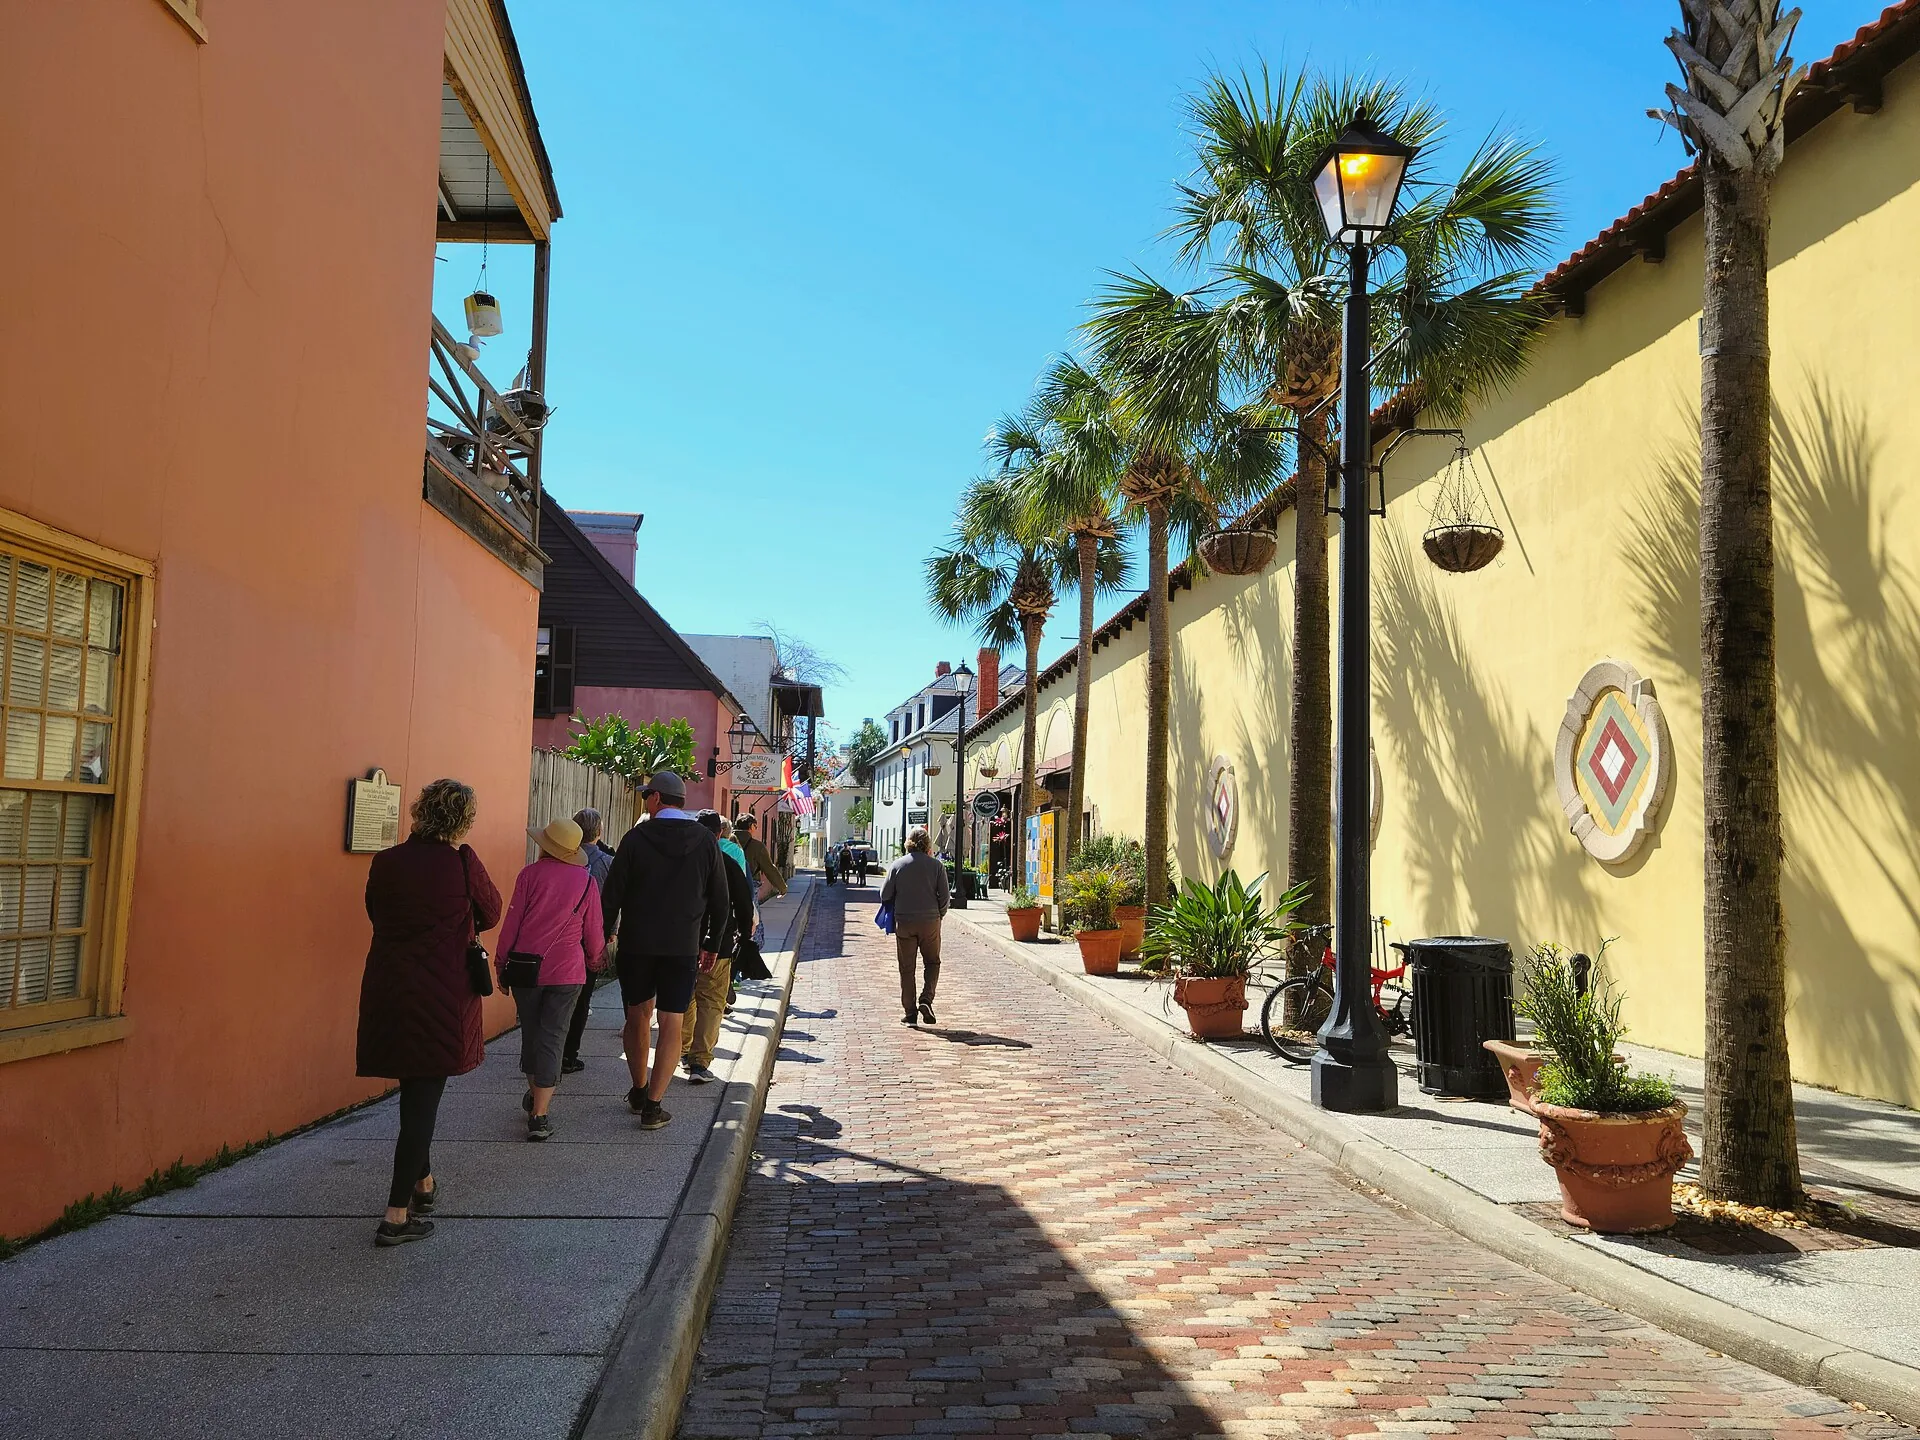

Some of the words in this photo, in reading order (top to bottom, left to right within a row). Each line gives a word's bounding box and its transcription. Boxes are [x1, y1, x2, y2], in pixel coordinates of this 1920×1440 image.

[756, 755, 776, 765] MILITARY
[736, 775, 757, 784] HOSPITAL
[757, 776, 776, 784] MUSEUM
